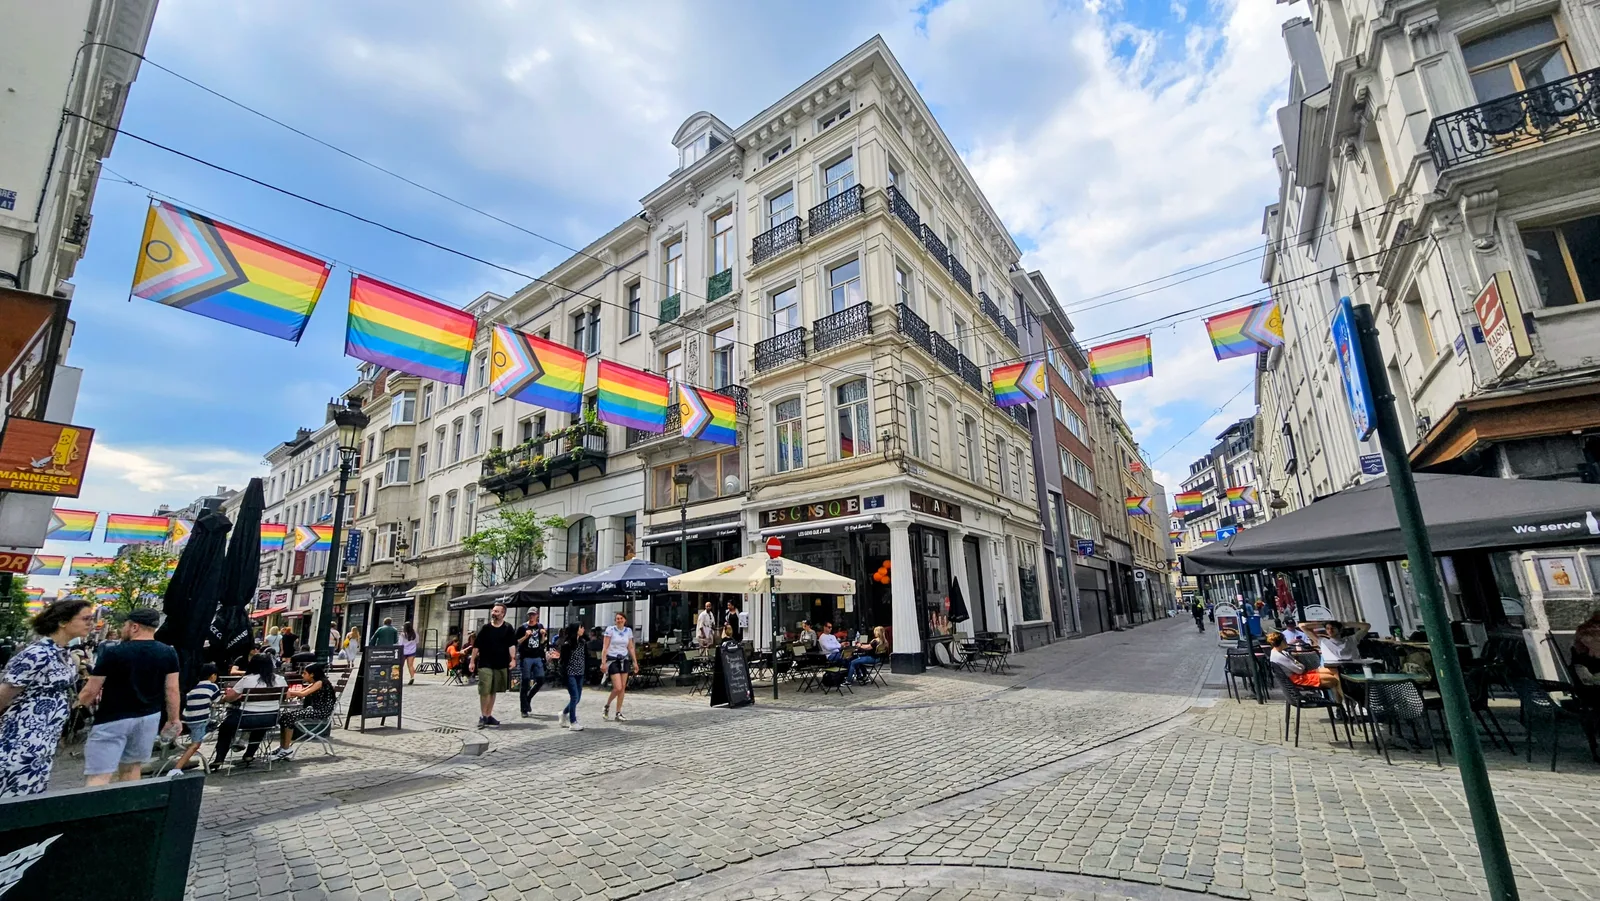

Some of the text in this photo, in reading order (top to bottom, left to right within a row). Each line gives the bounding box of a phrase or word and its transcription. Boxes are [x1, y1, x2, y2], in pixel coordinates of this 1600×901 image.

[1487, 323, 1508, 350] MAISON
[1494, 344, 1503, 357] DES
[1495, 343, 1515, 371] CREPES
[0, 470, 78, 486] MANNEKEN
[10, 480, 61, 493] FRITES
[790, 504, 825, 521] GNS
[828, 498, 859, 517] QE
[1512, 521, 1582, 534] We serve
